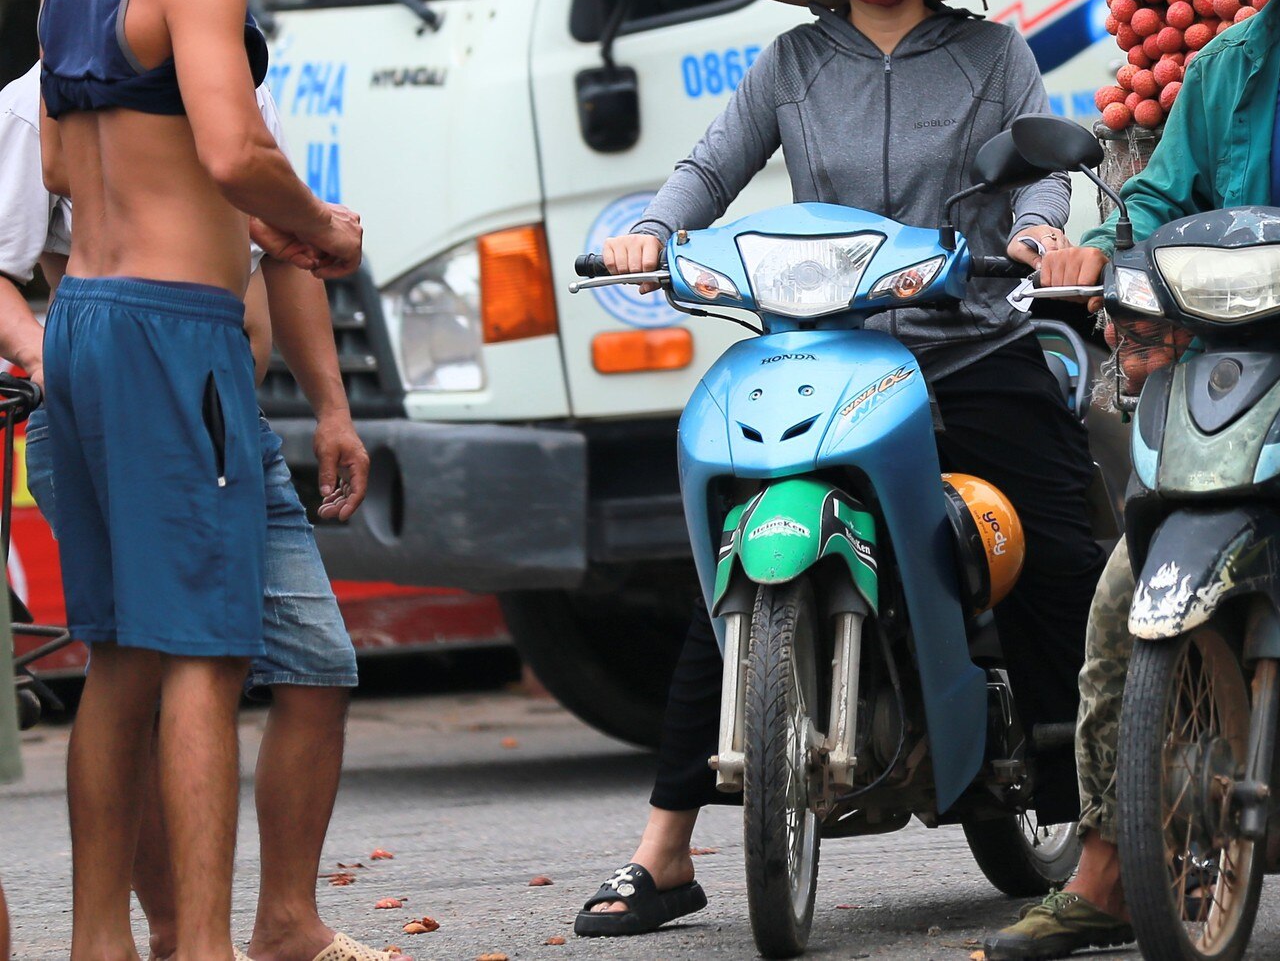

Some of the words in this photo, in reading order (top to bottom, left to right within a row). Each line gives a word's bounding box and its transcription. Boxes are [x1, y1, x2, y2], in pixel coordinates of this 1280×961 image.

[760, 353, 817, 366] HONDA
[840, 384, 877, 416] WAVE
[982, 511, 1007, 555] yody
